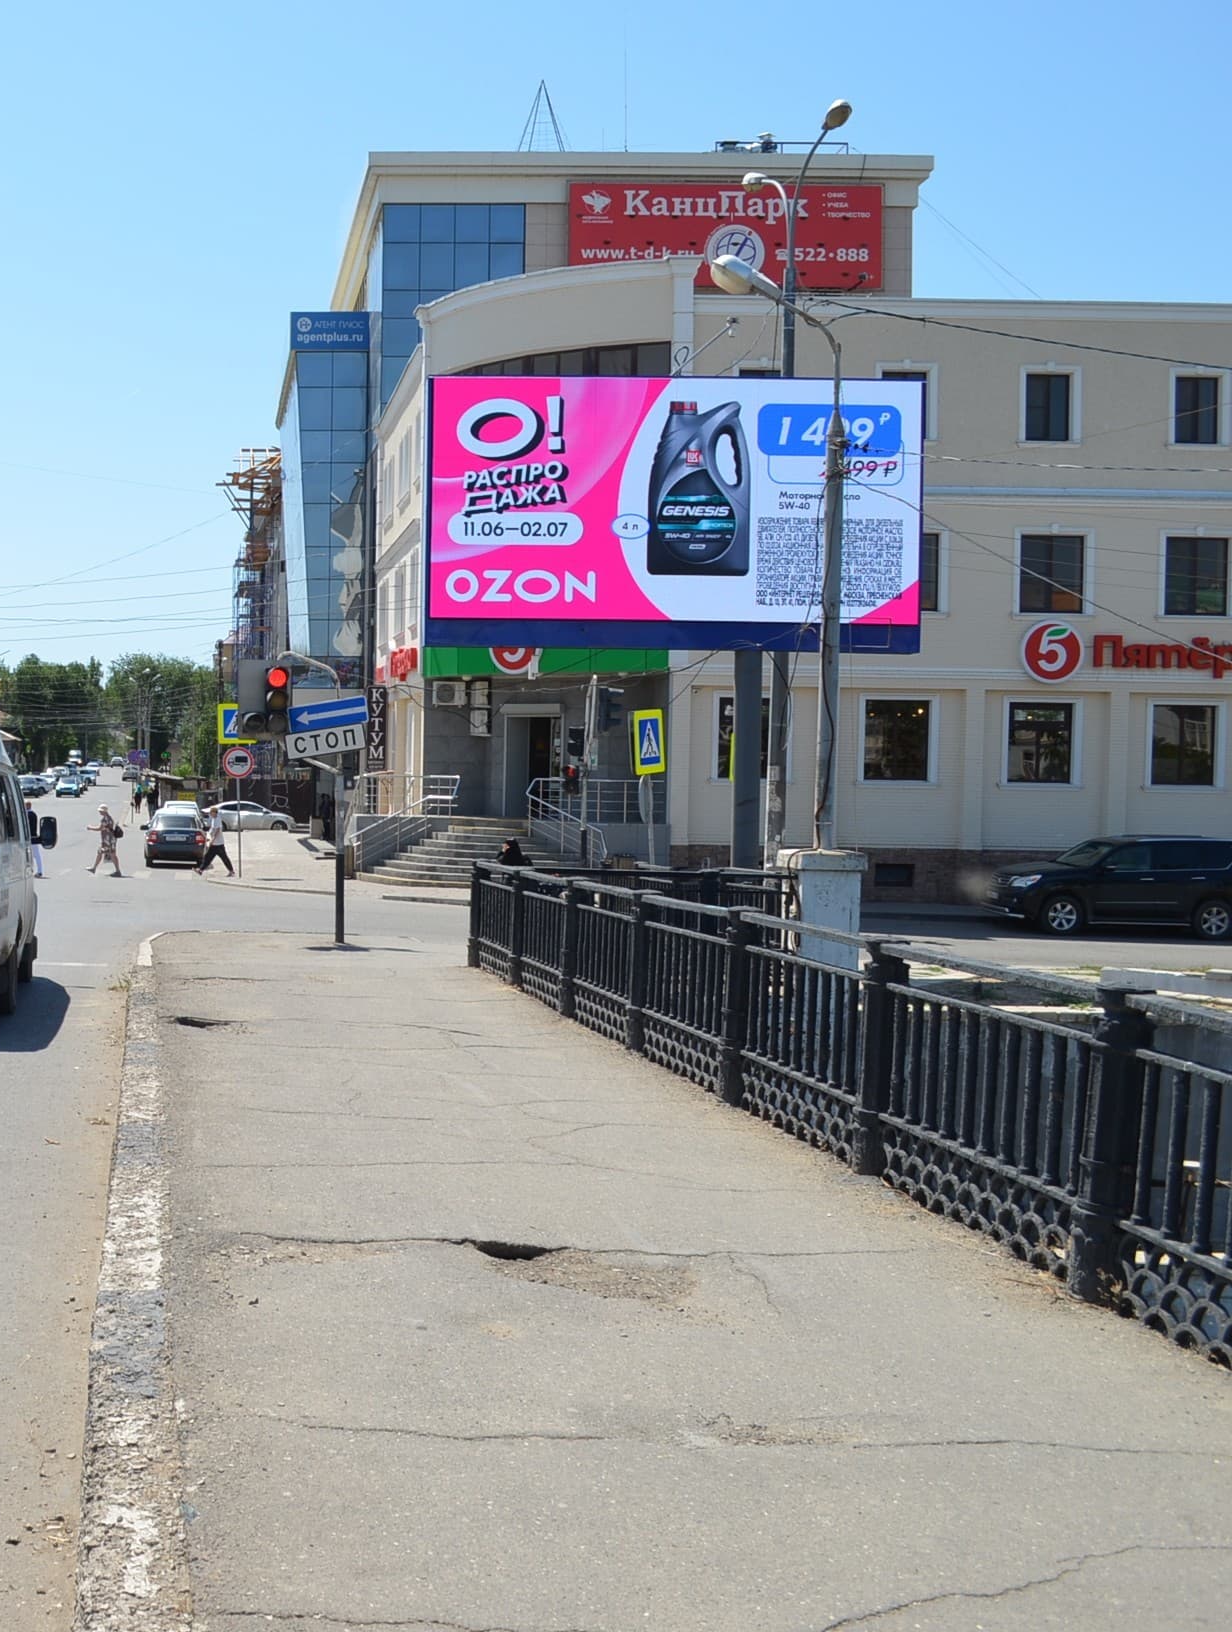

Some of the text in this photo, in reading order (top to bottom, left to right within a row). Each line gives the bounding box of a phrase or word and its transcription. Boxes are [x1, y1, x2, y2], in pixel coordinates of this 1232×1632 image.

[623, 190, 809, 224] КанцПарк
[297, 332, 363, 343] agentplus.ru
[314, 320, 336, 328] АГЕНТ
[801, 417, 875, 448] 49
[463, 461, 568, 489] РАСПРО
[462, 483, 567, 516] ДАЖА
[662, 505, 730, 517] GENESIS
[622, 522, 629, 530] 4
[445, 569, 596, 603] OZON
[368, 688, 384, 760] КУТУМ
[294, 729, 356, 754] СТОП
